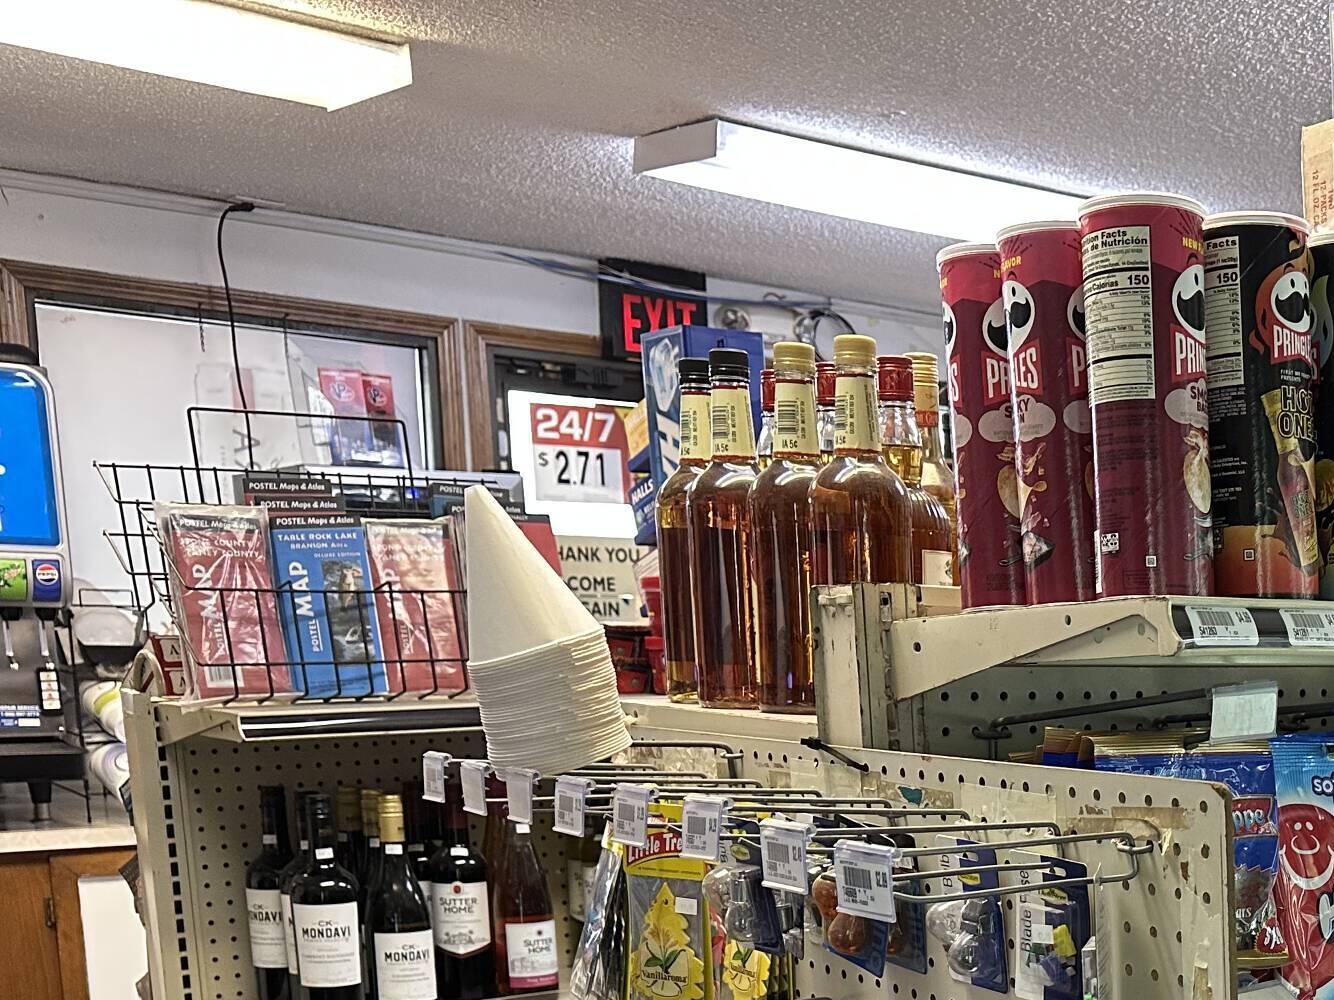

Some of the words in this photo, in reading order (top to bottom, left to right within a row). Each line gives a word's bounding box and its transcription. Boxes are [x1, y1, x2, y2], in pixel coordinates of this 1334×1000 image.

[1127, 274, 1150, 286] 150
[1216, 271, 1238, 285] 150
[535, 408, 617, 443] 24/7
[537, 451, 549, 467] $
[554, 450, 607, 487] 2.71
[248, 481, 278, 491] POSTEL
[632, 478, 655, 505] HALLS
[260, 499, 291, 509] POSTEL
[275, 516, 307, 526] POSTEL
[308, 516, 328, 527] Maps
[608, 547, 641, 564] YOU
[288, 560, 314, 618] MAP
[439, 896, 478, 907] SUTTER
[443, 905, 474, 914] HOME
[301, 925, 351, 940] MONDAVI
[1020, 909, 1032, 952] Blade
[384, 949, 430, 963] MONDAVI
